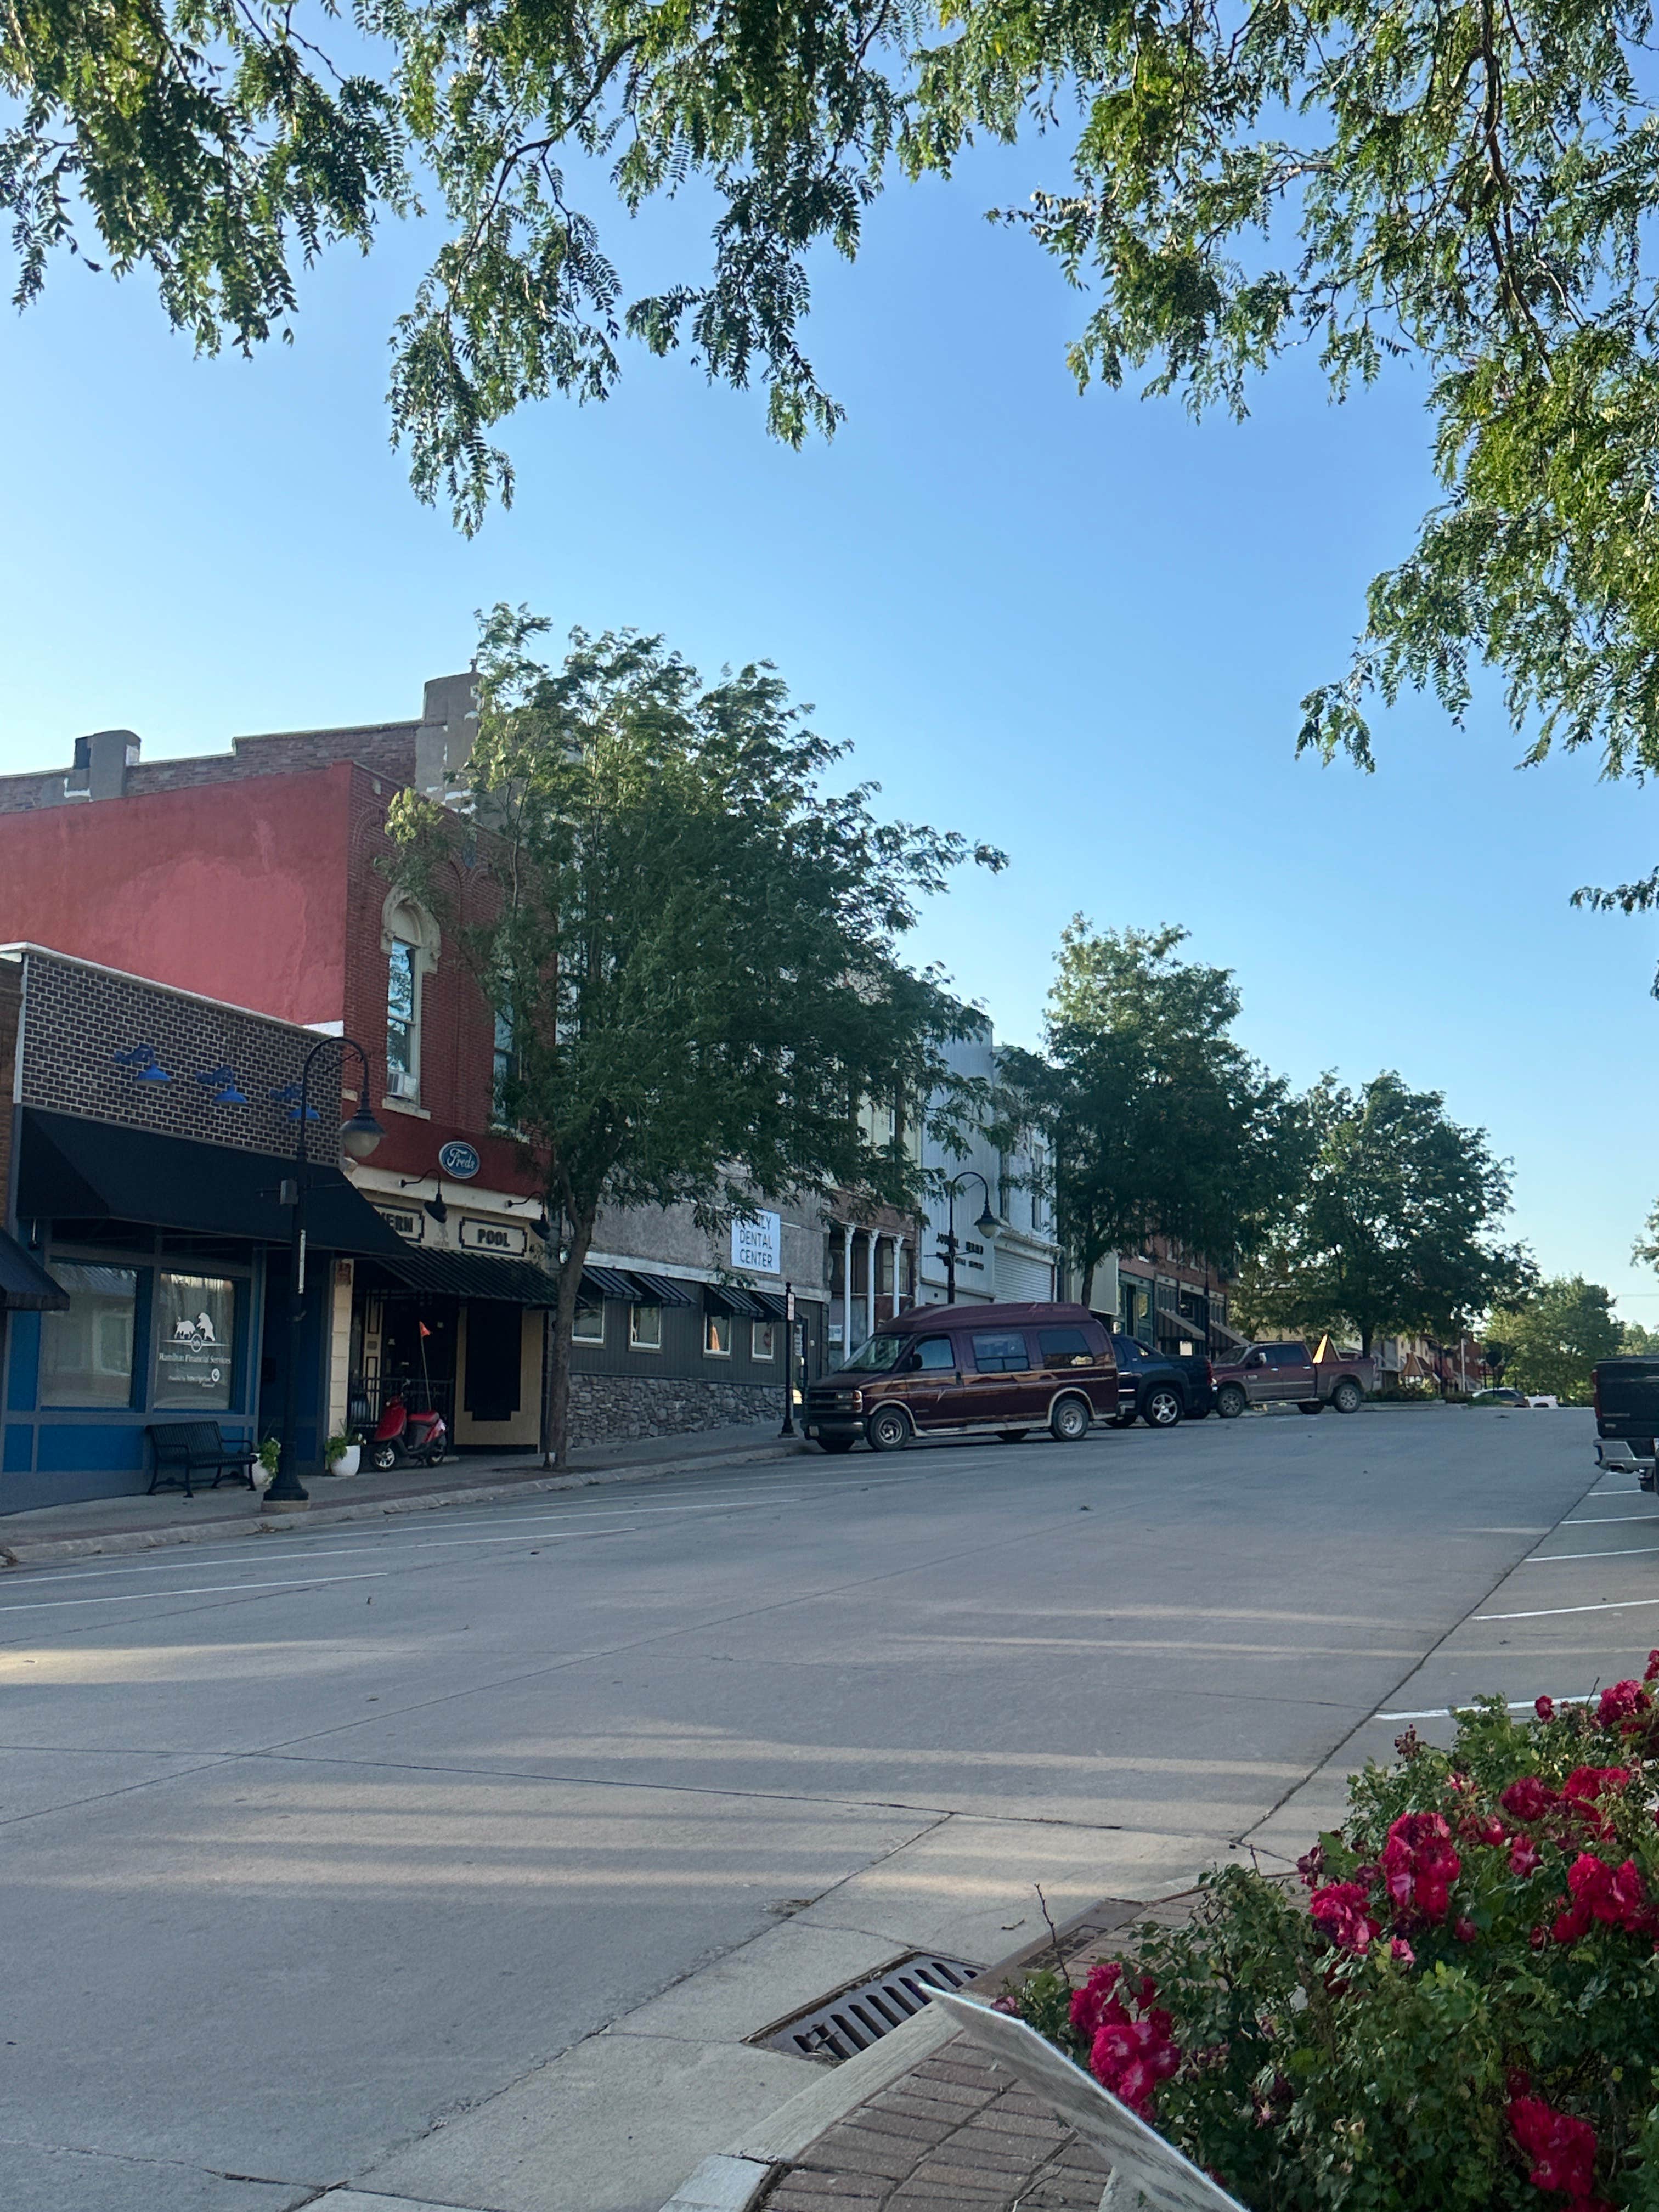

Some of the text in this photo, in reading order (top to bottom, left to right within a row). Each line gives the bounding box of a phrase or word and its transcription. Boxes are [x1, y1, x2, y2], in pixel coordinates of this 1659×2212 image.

[447, 1148, 475, 1170] Freds
[477, 1228, 510, 1247] POOL
[740, 1229, 772, 1250] DENTAL
[740, 1249, 772, 1268] CENTER
[185, 1354, 210, 1363] Financial
[210, 1356, 231, 1364] Services
